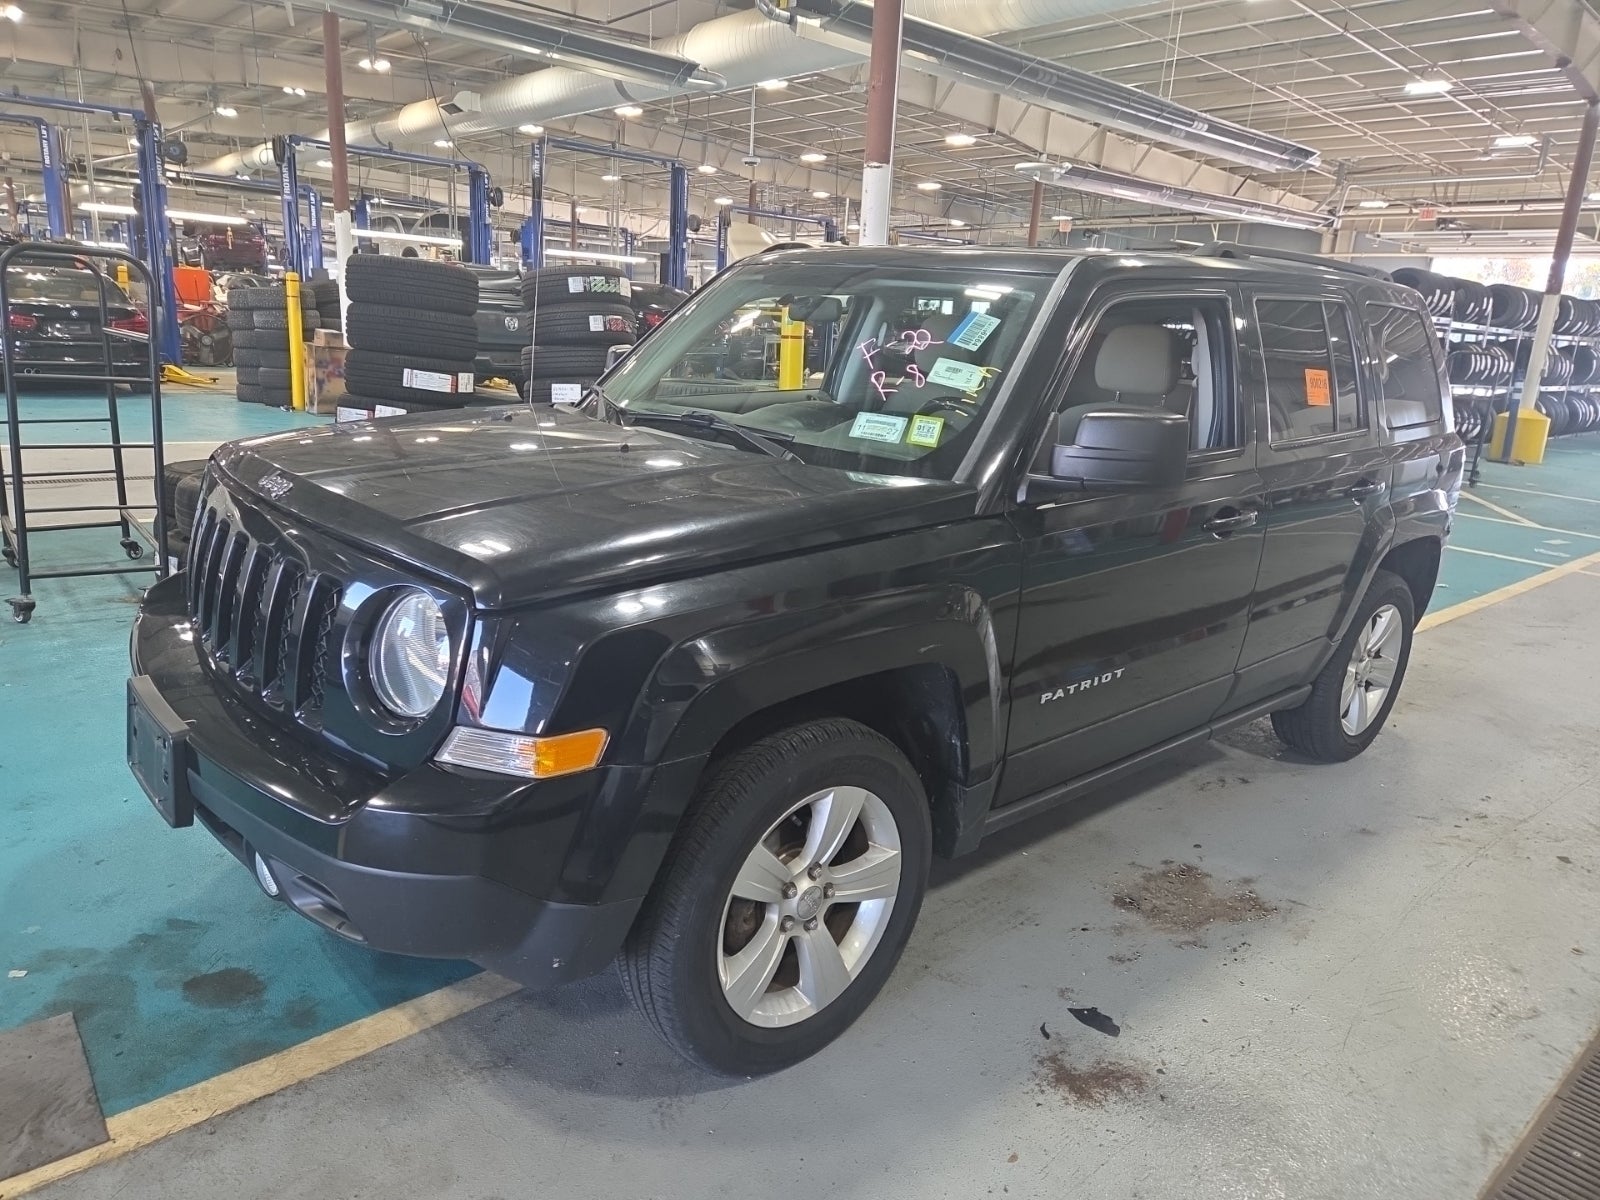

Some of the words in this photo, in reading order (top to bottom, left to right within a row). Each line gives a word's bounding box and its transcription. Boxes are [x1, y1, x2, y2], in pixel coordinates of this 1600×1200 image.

[41, 124, 49, 138] LIFT
[42, 140, 51, 165] ROTARY
[1040, 667, 1126, 705] PATRIOT
